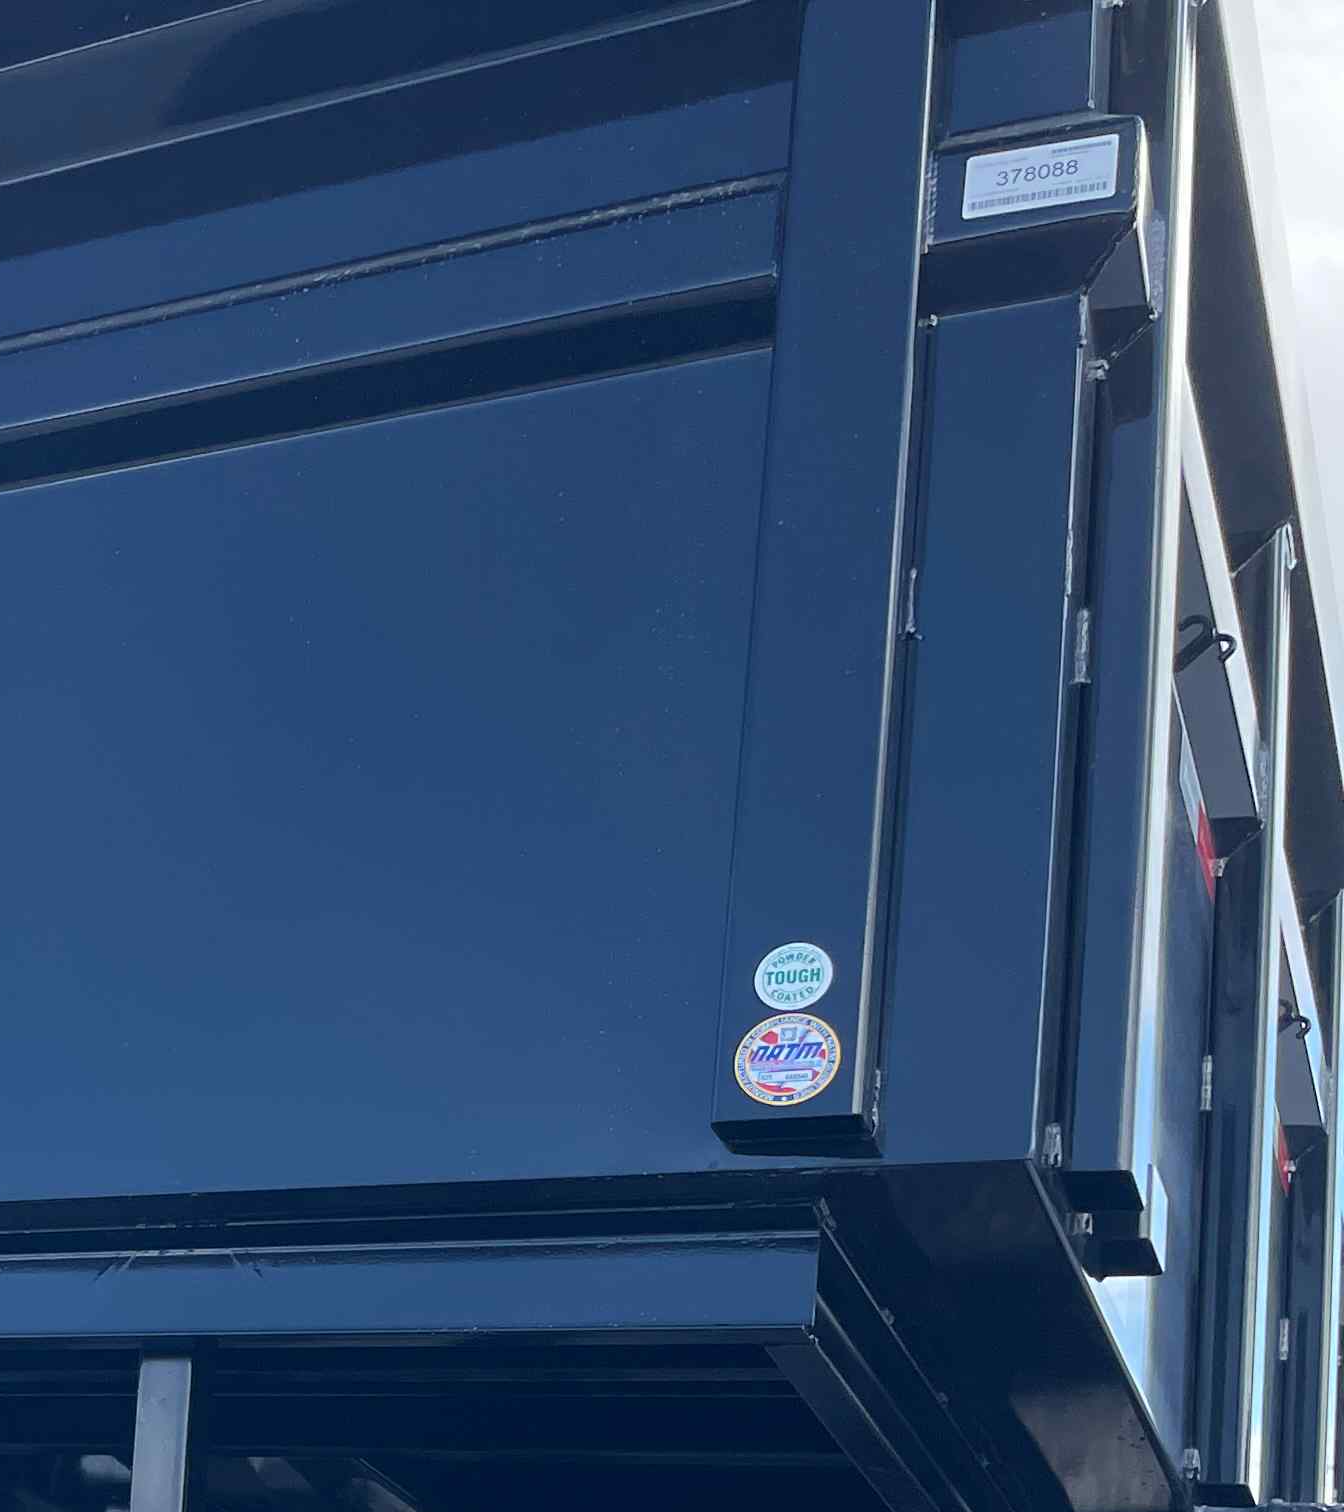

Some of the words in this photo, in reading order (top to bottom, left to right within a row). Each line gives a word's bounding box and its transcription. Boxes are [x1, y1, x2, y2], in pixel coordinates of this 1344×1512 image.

[996, 160, 1079, 186] 378088
[765, 968, 821, 986] TOUGH
[771, 986, 813, 1001] COATED
